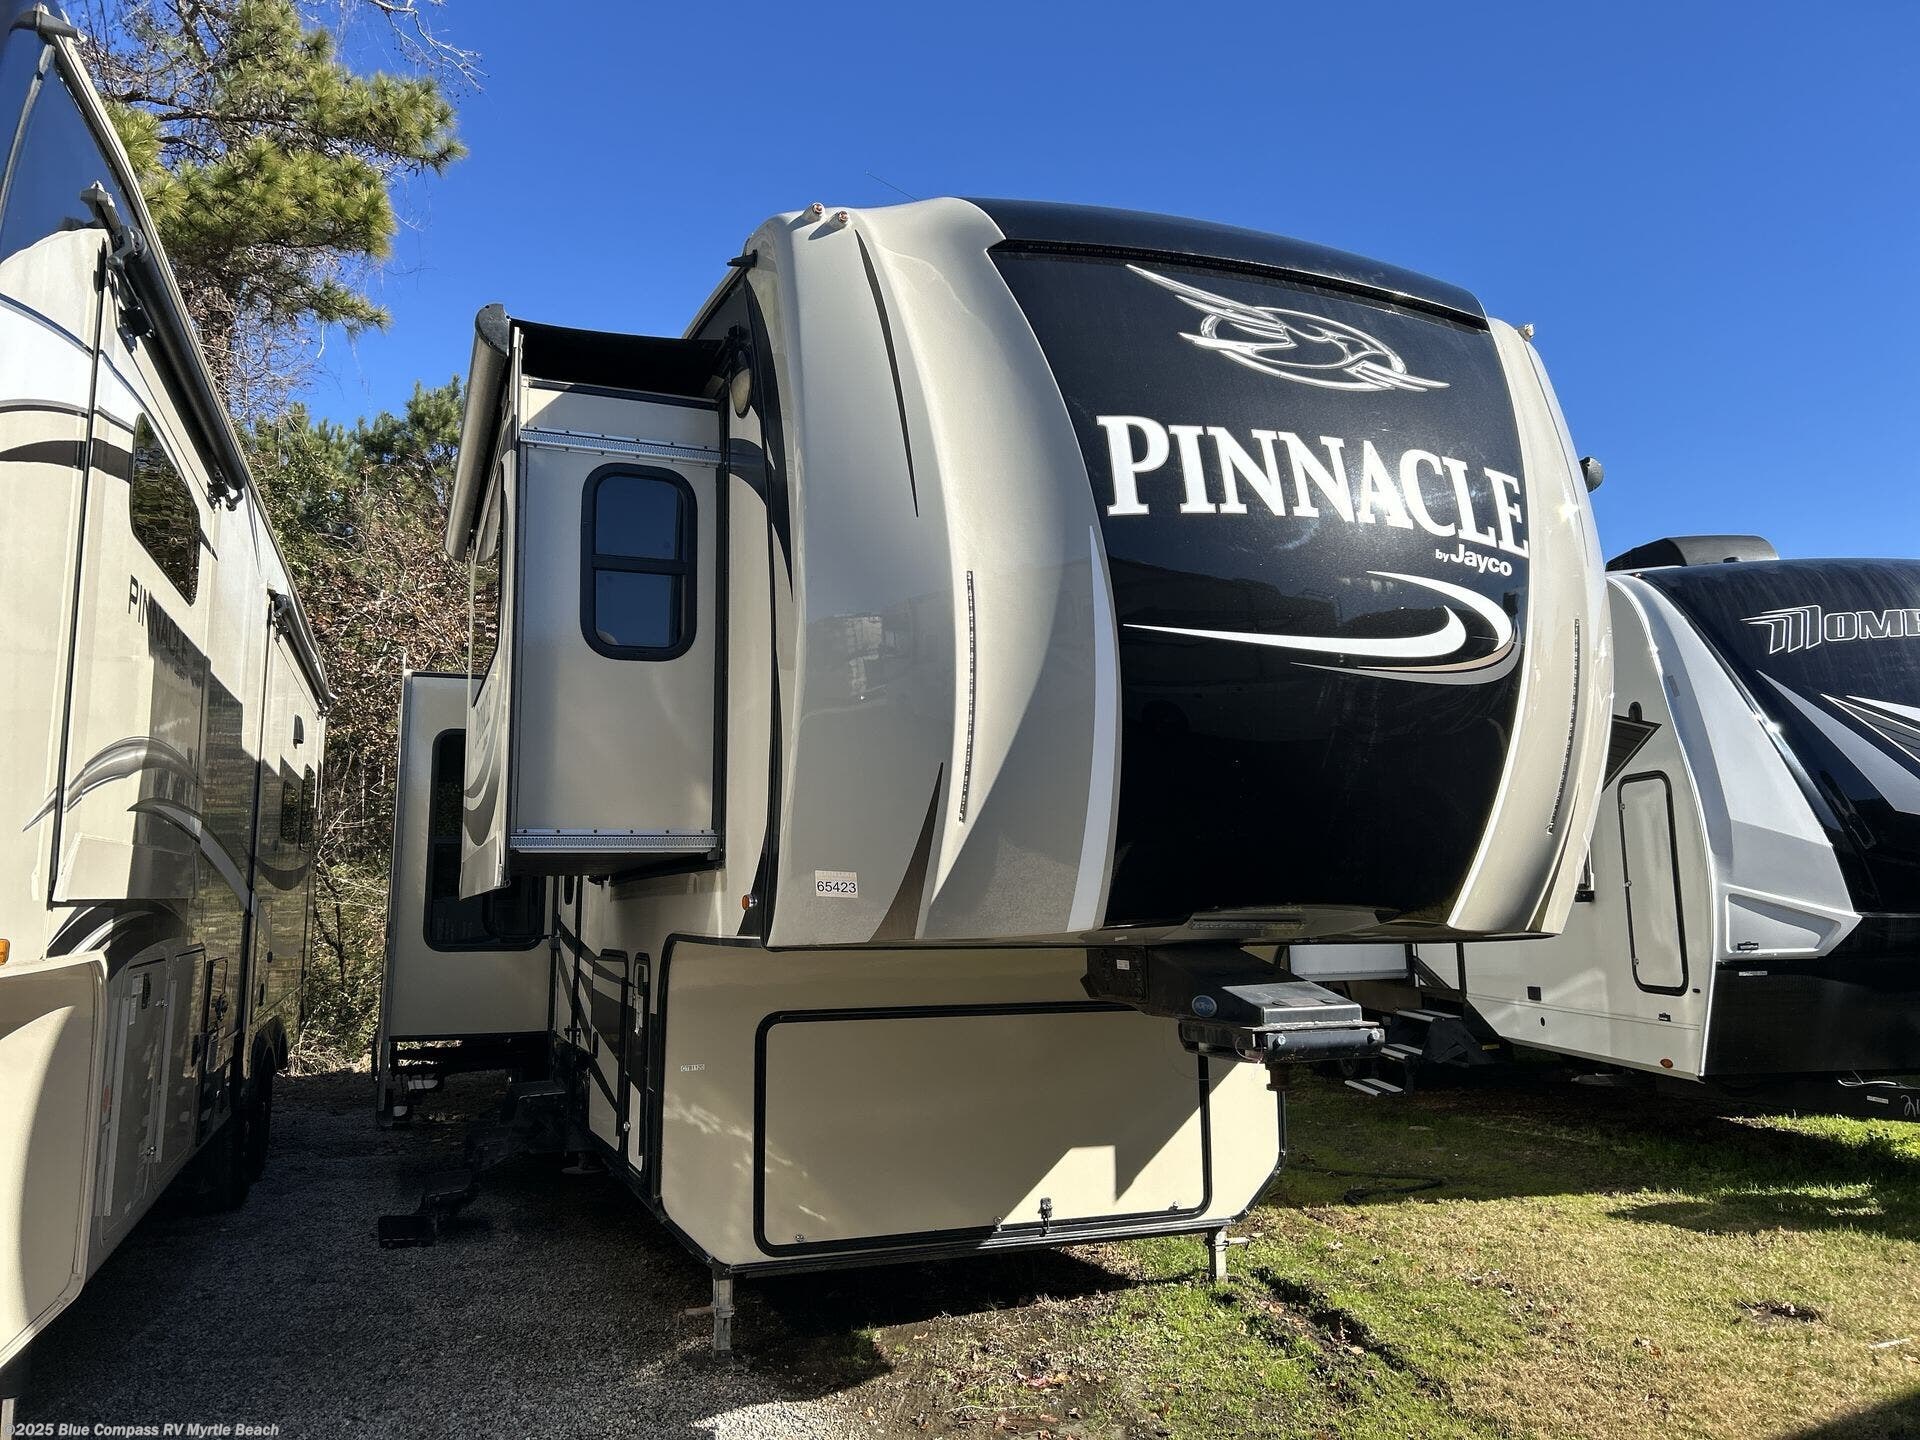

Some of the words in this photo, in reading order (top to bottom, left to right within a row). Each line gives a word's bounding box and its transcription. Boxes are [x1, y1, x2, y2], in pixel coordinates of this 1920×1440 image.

[1096, 415, 1529, 558] PINNACLE
[1435, 548, 1450, 562] by
[1450, 543, 1513, 577] Jayco
[817, 880, 857, 893] 65423
